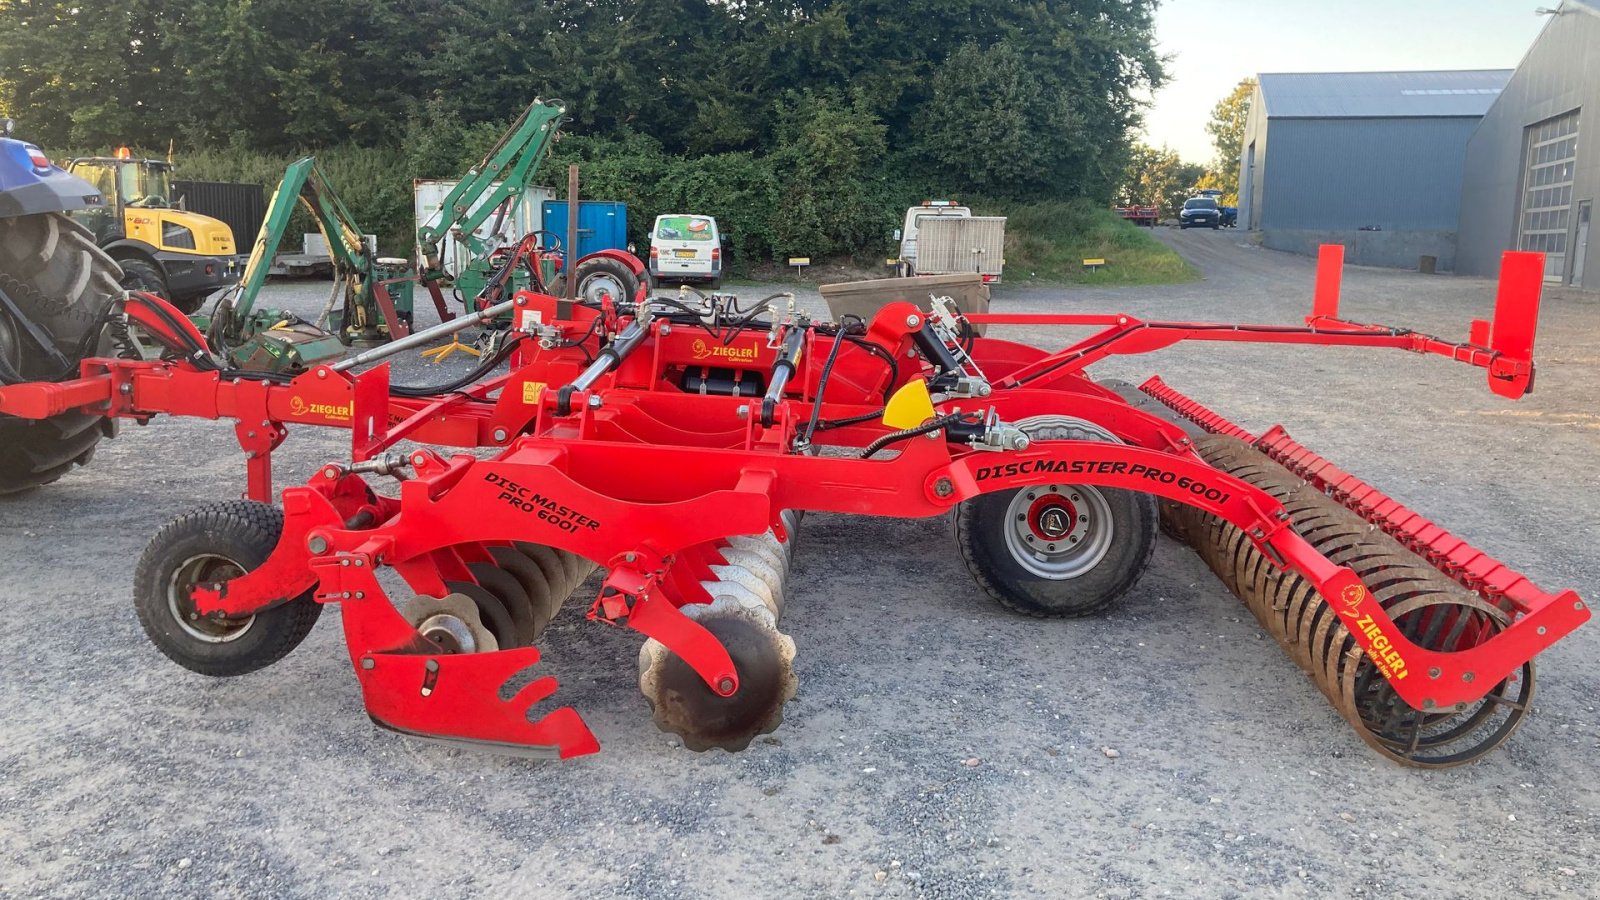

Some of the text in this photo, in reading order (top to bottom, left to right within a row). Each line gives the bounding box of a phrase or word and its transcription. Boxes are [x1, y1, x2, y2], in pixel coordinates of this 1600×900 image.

[712, 346, 753, 358] ZIEGLER
[310, 404, 349, 416] ZIEGLER
[484, 472, 600, 531] DISC MASTER
[975, 460, 1231, 505] DISC MASTER PRO 6001
[497, 492, 579, 533] PRO 6001
[1356, 614, 1405, 673] ZIEGLER
